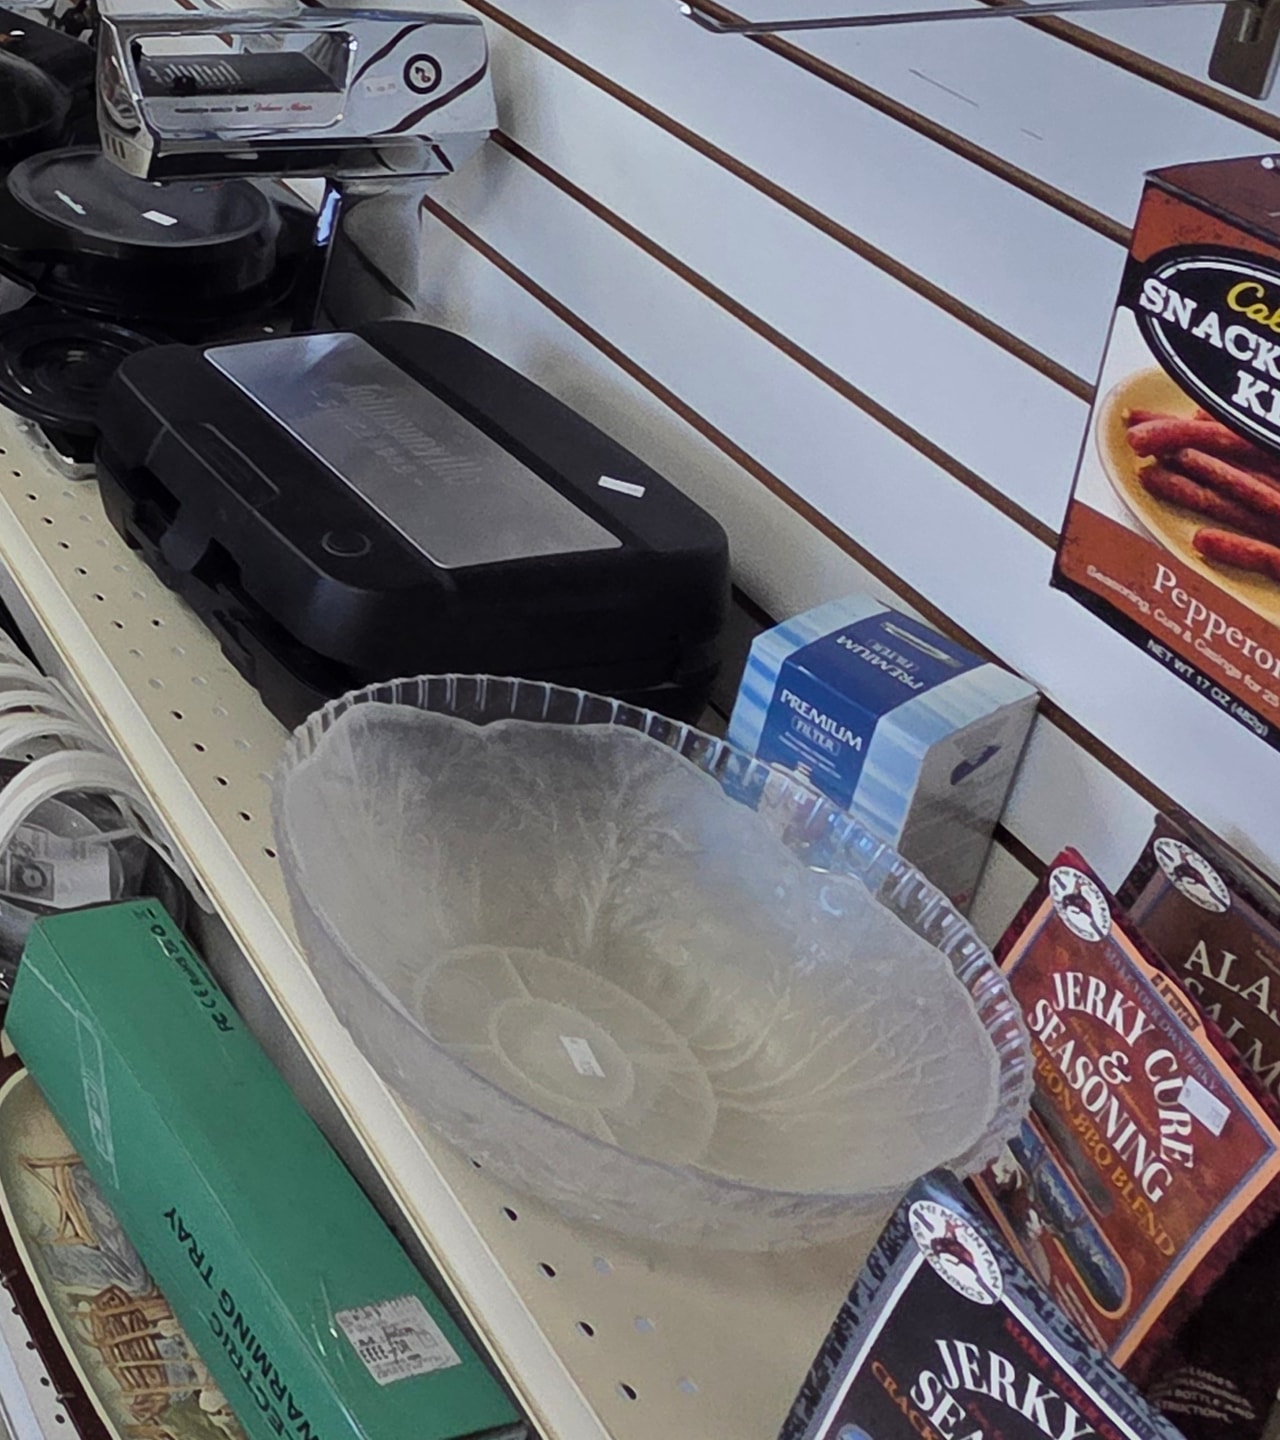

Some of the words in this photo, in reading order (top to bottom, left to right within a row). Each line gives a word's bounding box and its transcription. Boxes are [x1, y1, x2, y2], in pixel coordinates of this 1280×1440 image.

[836, 634, 924, 691] PREMIUM
[1147, 638, 1175, 662] NET
[1174, 658, 1196, 679] WT
[1195, 674, 1211, 690] 17
[1210, 686, 1232, 707] OZ
[1243, 673, 1262, 693] for
[780, 688, 863, 752] PREMIUM
[795, 718, 835, 753] FILTER
[1027, 998, 1174, 1204] SEASONING
[1052, 971, 1155, 1047] JERKY
[1144, 1048, 1195, 1170] CURE
[1098, 1050, 1132, 1085] &
[1111, 1165, 1176, 1257] BLEND
[164, 1207, 217, 1290] TRAY
[935, 1339, 1095, 1440] JERKY
